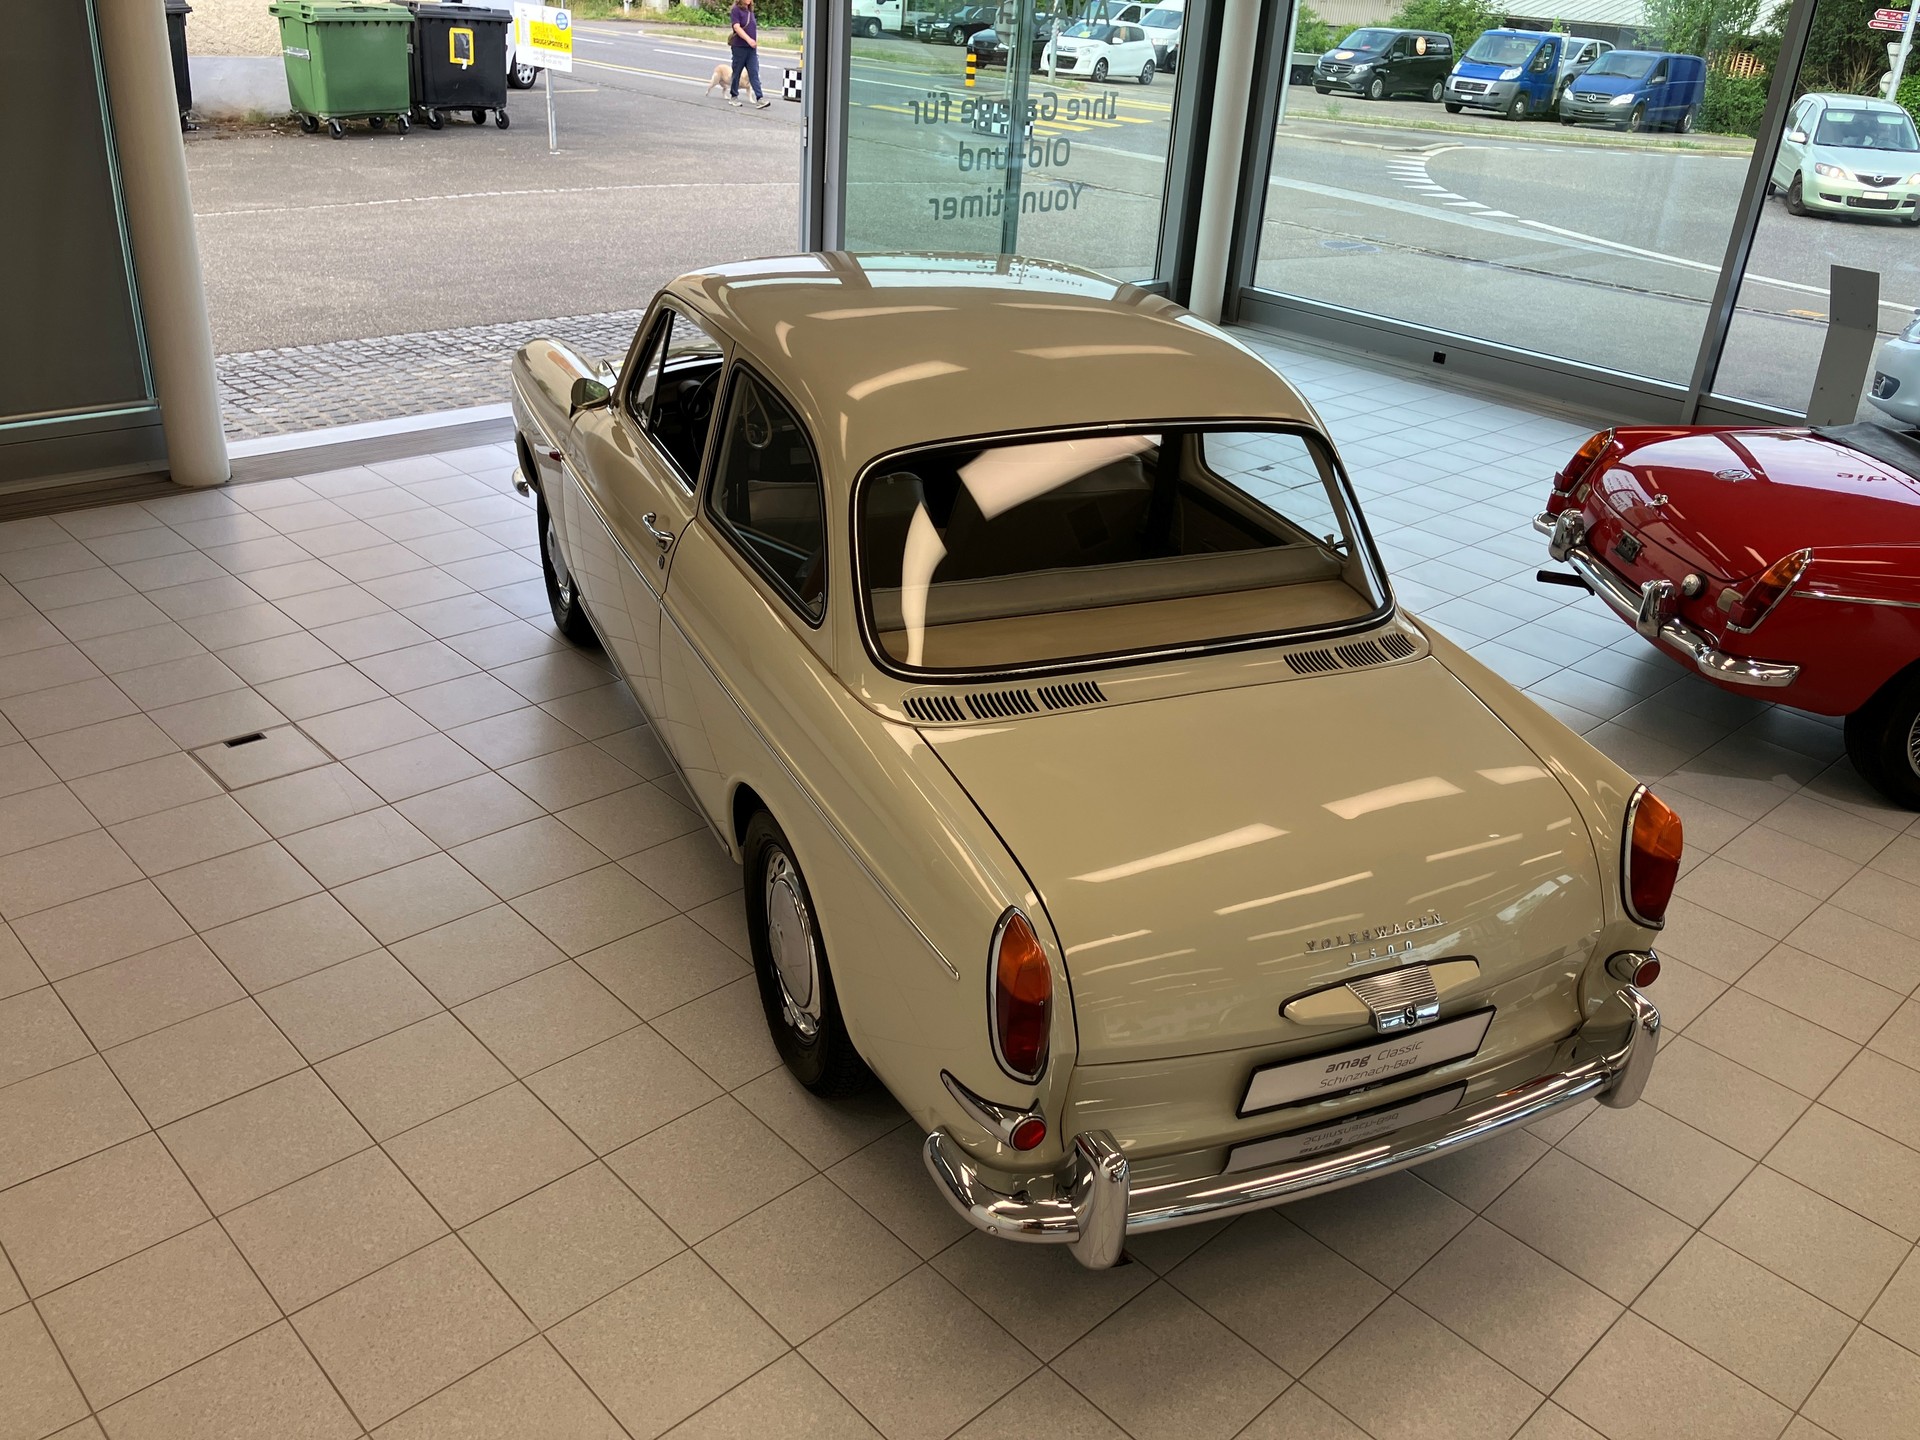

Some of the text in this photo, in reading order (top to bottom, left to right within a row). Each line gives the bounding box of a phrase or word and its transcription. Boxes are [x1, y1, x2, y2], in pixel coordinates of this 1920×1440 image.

[1305, 913, 1444, 952] VOLKSWAGEN
[1350, 940, 1414, 963] 1500
[1319, 1055, 1418, 1089] Schinznach-Bad
[1325, 1041, 1424, 1074] amag Classic
